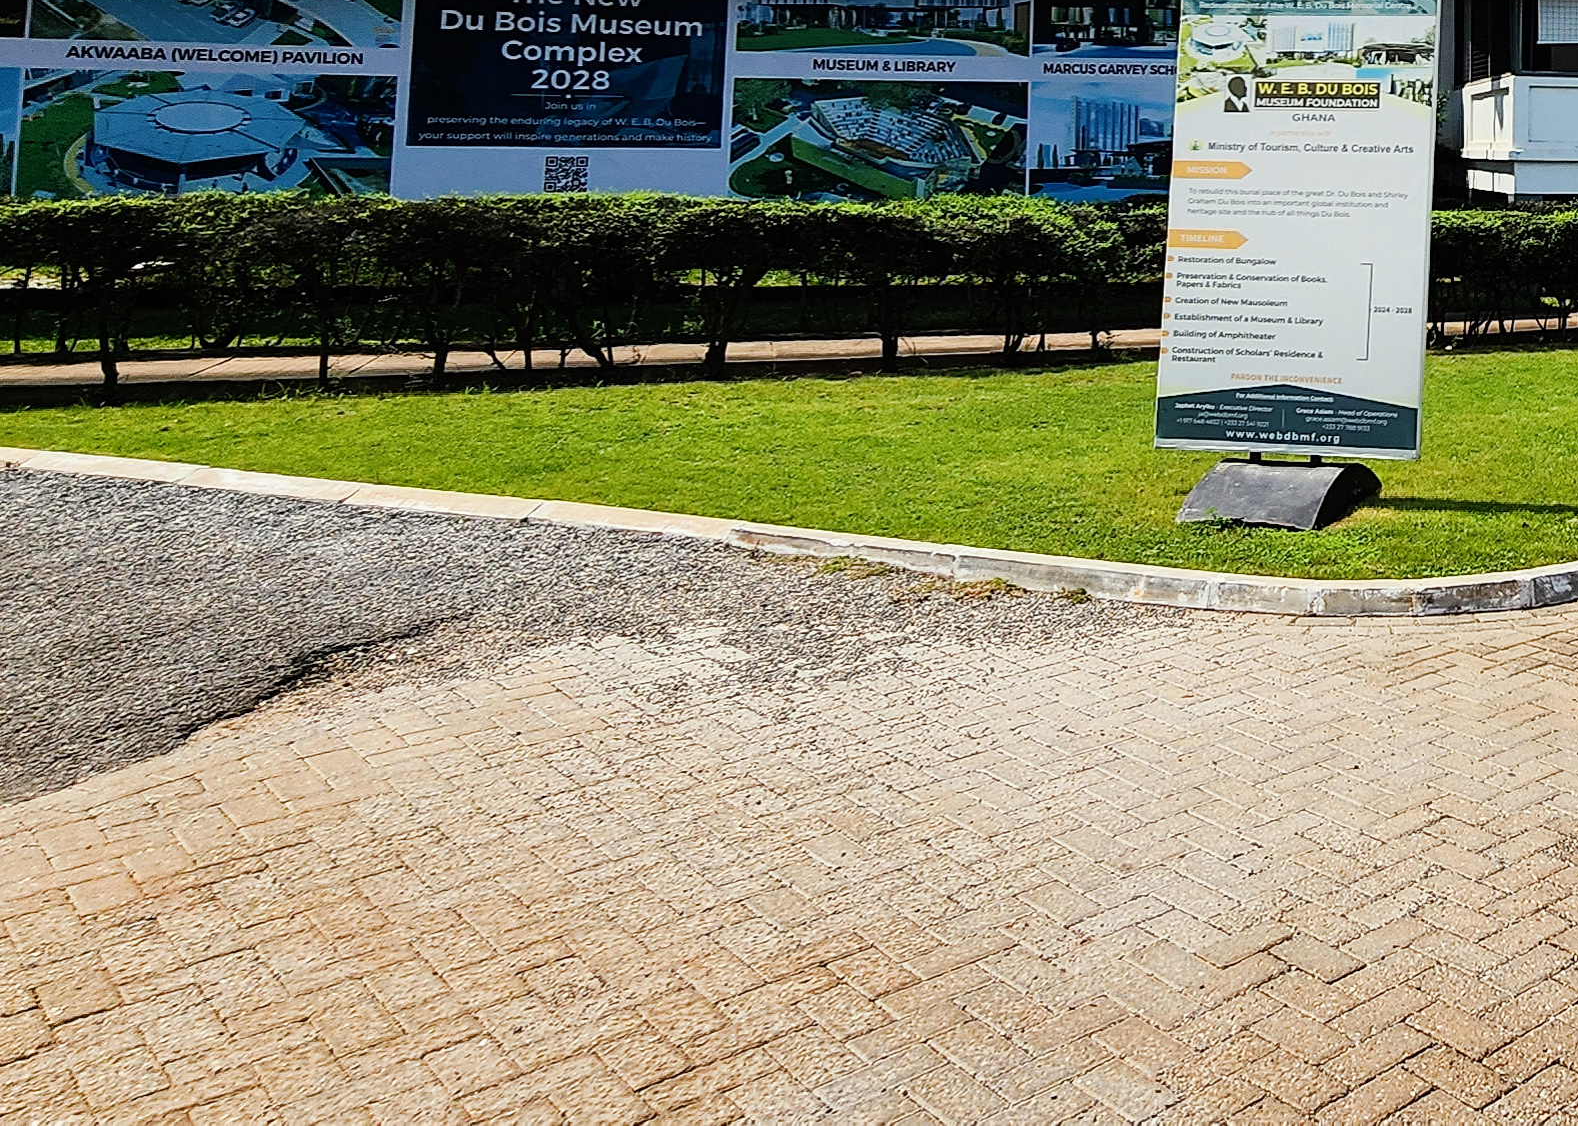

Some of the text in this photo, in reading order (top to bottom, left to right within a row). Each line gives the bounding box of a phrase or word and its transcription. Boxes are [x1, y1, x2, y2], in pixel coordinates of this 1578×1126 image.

[440, 10, 703, 37] Du Bois Museum
[66, 45, 364, 65] AKWAABA (WELCOME) PAVILION
[501, 40, 643, 66] Complex
[812, 59, 956, 73] MUSEUM & LIBRARY
[1043, 62, 1177, 75] MARCUS GARVEY SCH
[531, 69, 611, 90] 2028
[1258, 83, 1379, 95] W. E. B. DU BOIS
[544, 101, 568, 110] Join
[586, 102, 597, 110] in
[1256, 98, 1378, 107] MUSEUM FOUNDATION
[427, 116, 487, 126] preserving
[489, 116, 508, 125] the
[510, 117, 560, 127] enduring
[563, 117, 600, 128] legacy
[601, 117, 613, 126] of
[656, 118, 672, 126] Du
[1292, 113, 1336, 122] GHANA
[418, 131, 713, 143] your support will inspire generations and make history
[1208, 142, 1414, 153] Ministry of Tourism, Culture & Creative Arts
[1186, 165, 1228, 174] MISSION
[1305, 190, 1324, 198] great
[1188, 197, 1216, 205] Graham
[1311, 200, 1334, 208] global
[1180, 234, 1224, 243] TIMELINE
[1178, 255, 1277, 266] Restoration of Bungalow
[1176, 272, 1227, 280] Preservation
[1236, 273, 1289, 282] Conservation
[1291, 274, 1300, 282] of
[1176, 280, 1203, 289] Papers
[1212, 281, 1241, 289] Fabrics
[1175, 296, 1209, 304] Creation
[1211, 297, 1220, 305] of
[1240, 298, 1287, 307] Mausoleum
[1174, 313, 1232, 322] Establishment
[1234, 314, 1243, 322] of
[1250, 315, 1285, 323] Museum
[1294, 317, 1324, 326] Library
[1173, 330, 1207, 339] Building
[1219, 331, 1276, 340] Amphitheater
[1172, 346, 1224, 354] Construction
[1225, 347, 1235, 355] of
[1274, 349, 1316, 358] Residence
[1171, 354, 1216, 363] Restaurant
[1230, 373, 1343, 384] PARDON THE INCONVENIENCE
[1225, 430, 1340, 444] www.webdbmf.org
